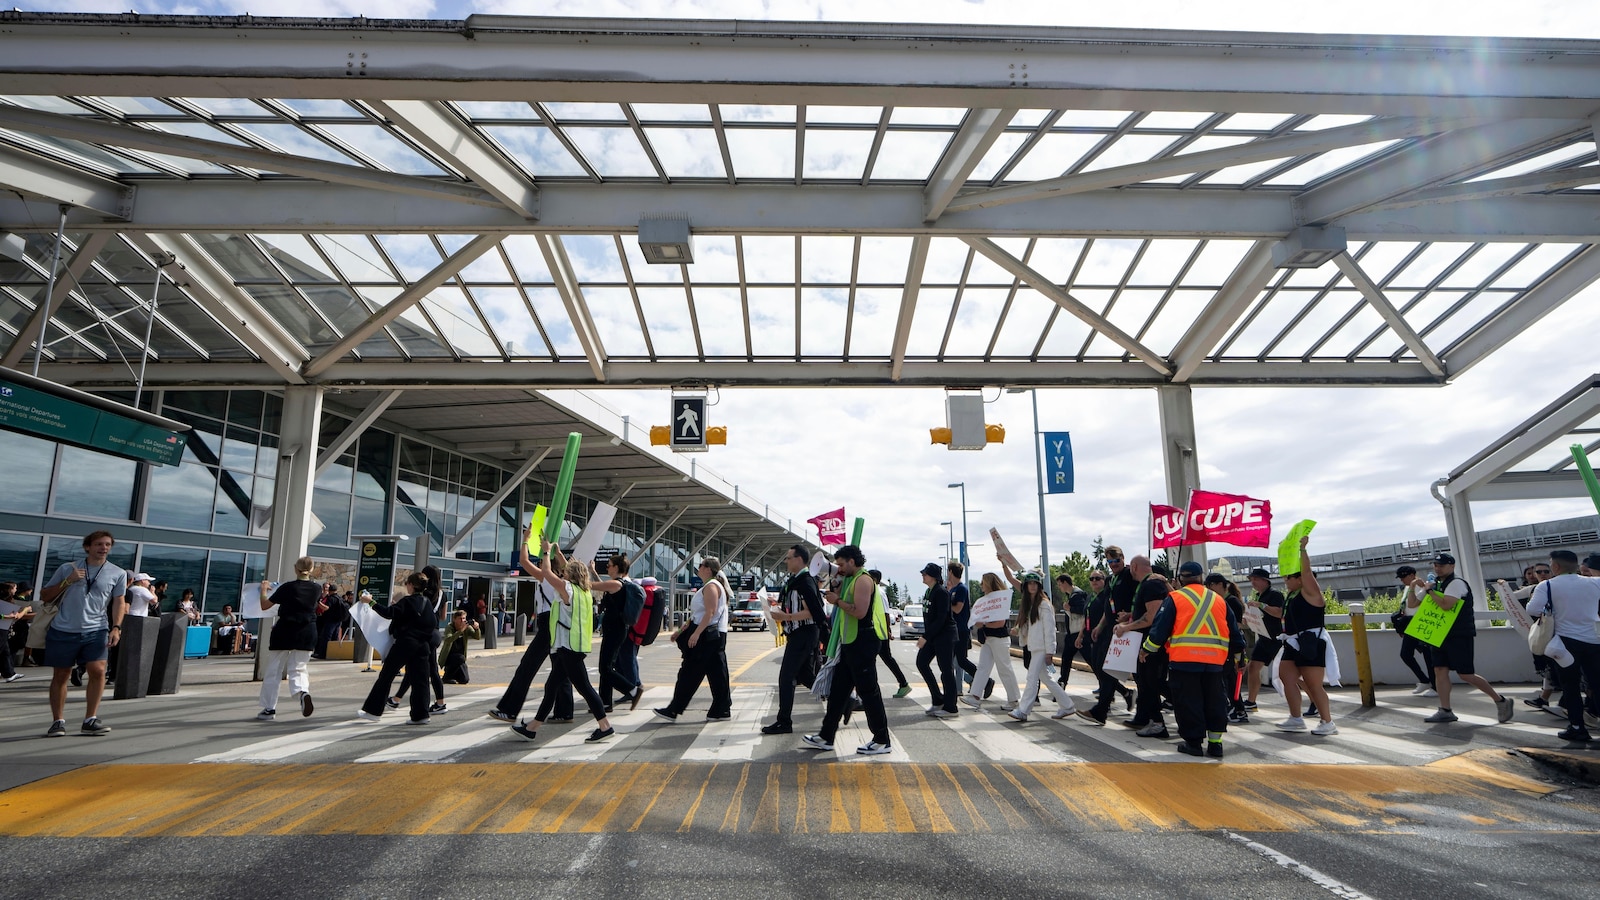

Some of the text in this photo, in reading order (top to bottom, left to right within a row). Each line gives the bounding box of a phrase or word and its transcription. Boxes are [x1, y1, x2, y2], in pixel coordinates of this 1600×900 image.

[1052, 440, 1066, 485] YVR
[1190, 500, 1264, 532] CUPE
[1246, 524, 1268, 532] Employees
[1424, 609, 1446, 624] work
[1416, 623, 1433, 640] fly
[1114, 638, 1130, 646] work
[1113, 646, 1122, 657] fly
